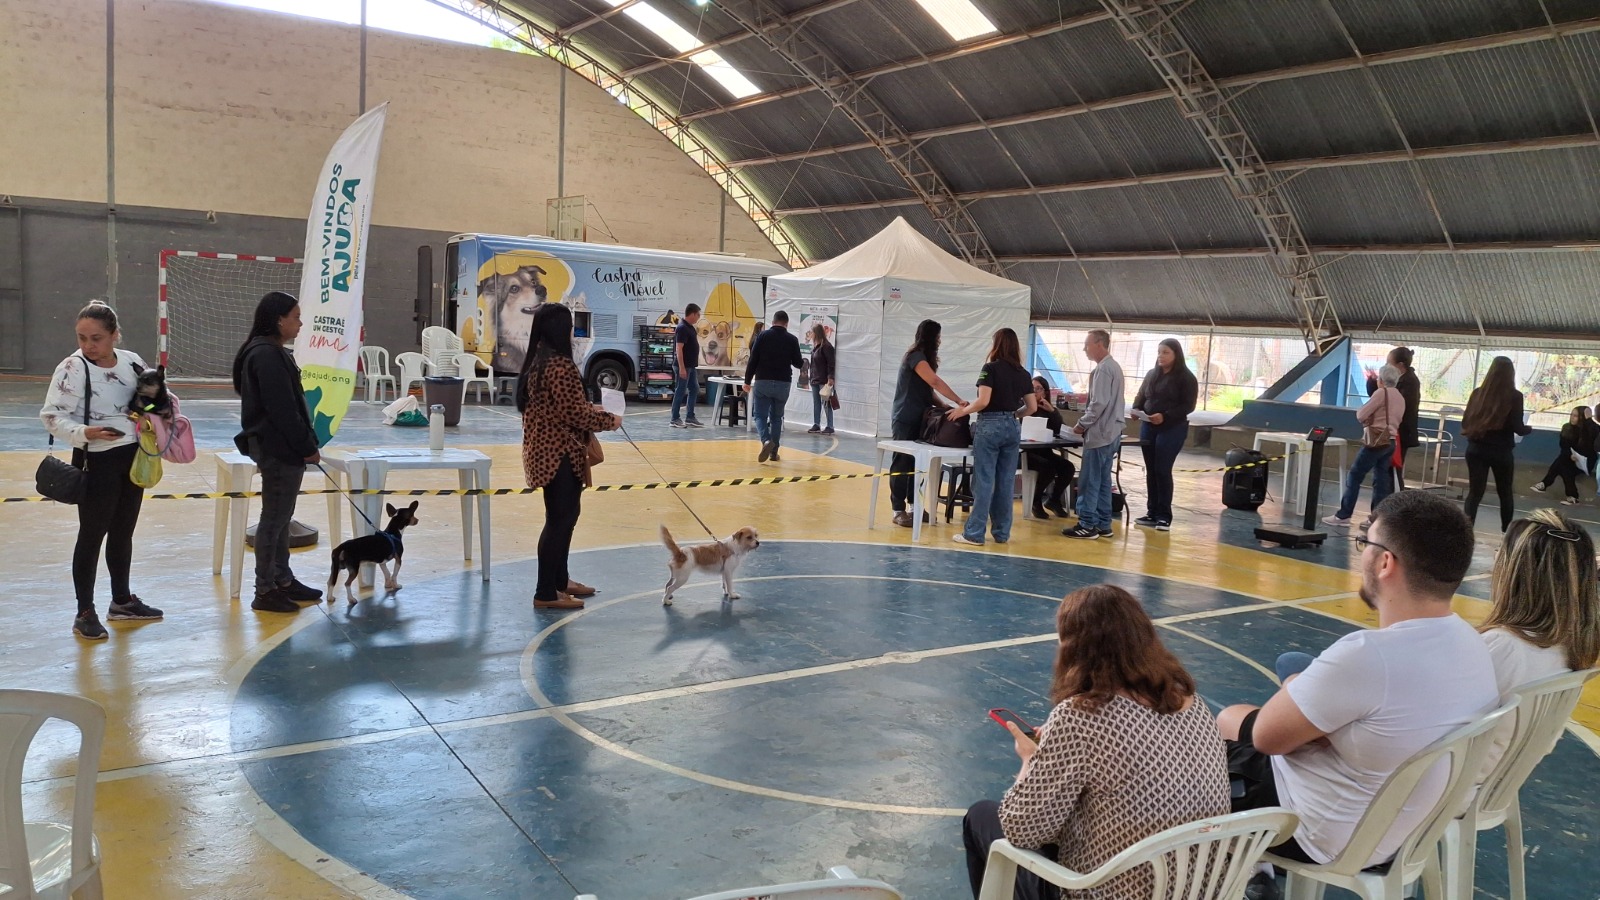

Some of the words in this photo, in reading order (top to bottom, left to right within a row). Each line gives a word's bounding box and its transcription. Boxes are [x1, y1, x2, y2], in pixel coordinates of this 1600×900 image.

[320, 163, 343, 304] BEM-VINDOS
[332, 178, 361, 293] AJUDA
[592, 266, 643, 284] Castra
[620, 280, 667, 297] Móvel
